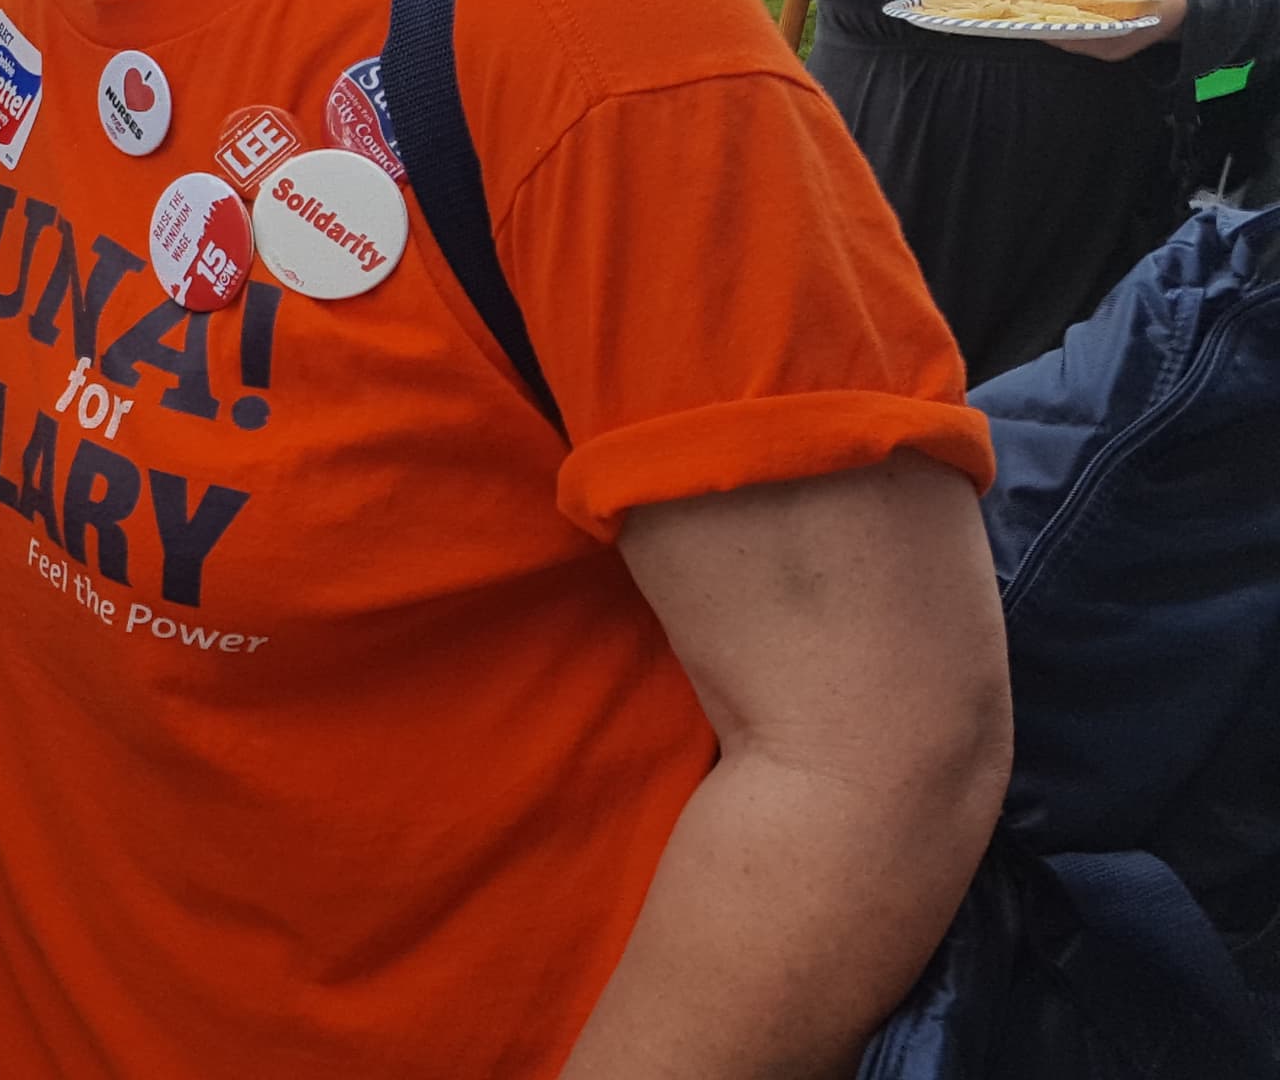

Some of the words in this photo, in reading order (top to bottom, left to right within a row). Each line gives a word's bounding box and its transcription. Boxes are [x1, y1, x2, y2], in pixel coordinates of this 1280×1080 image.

[144, 70, 152, 82] I
[105, 85, 144, 141] NURSES
[331, 92, 358, 124] City
[355, 123, 405, 179] Council
[222, 118, 290, 179] LEE
[153, 210, 173, 240] RAISE
[169, 189, 185, 214] THE
[162, 203, 193, 252] MINIMUM
[272, 178, 388, 273] Solidarity
[171, 233, 192, 262] WAGE
[197, 240, 227, 284] 15
[213, 259, 238, 297] NOW
[55, 356, 134, 439] for
[27, 537, 68, 592] Feel
[74, 573, 116, 625] the
[126, 602, 269, 653] Power
